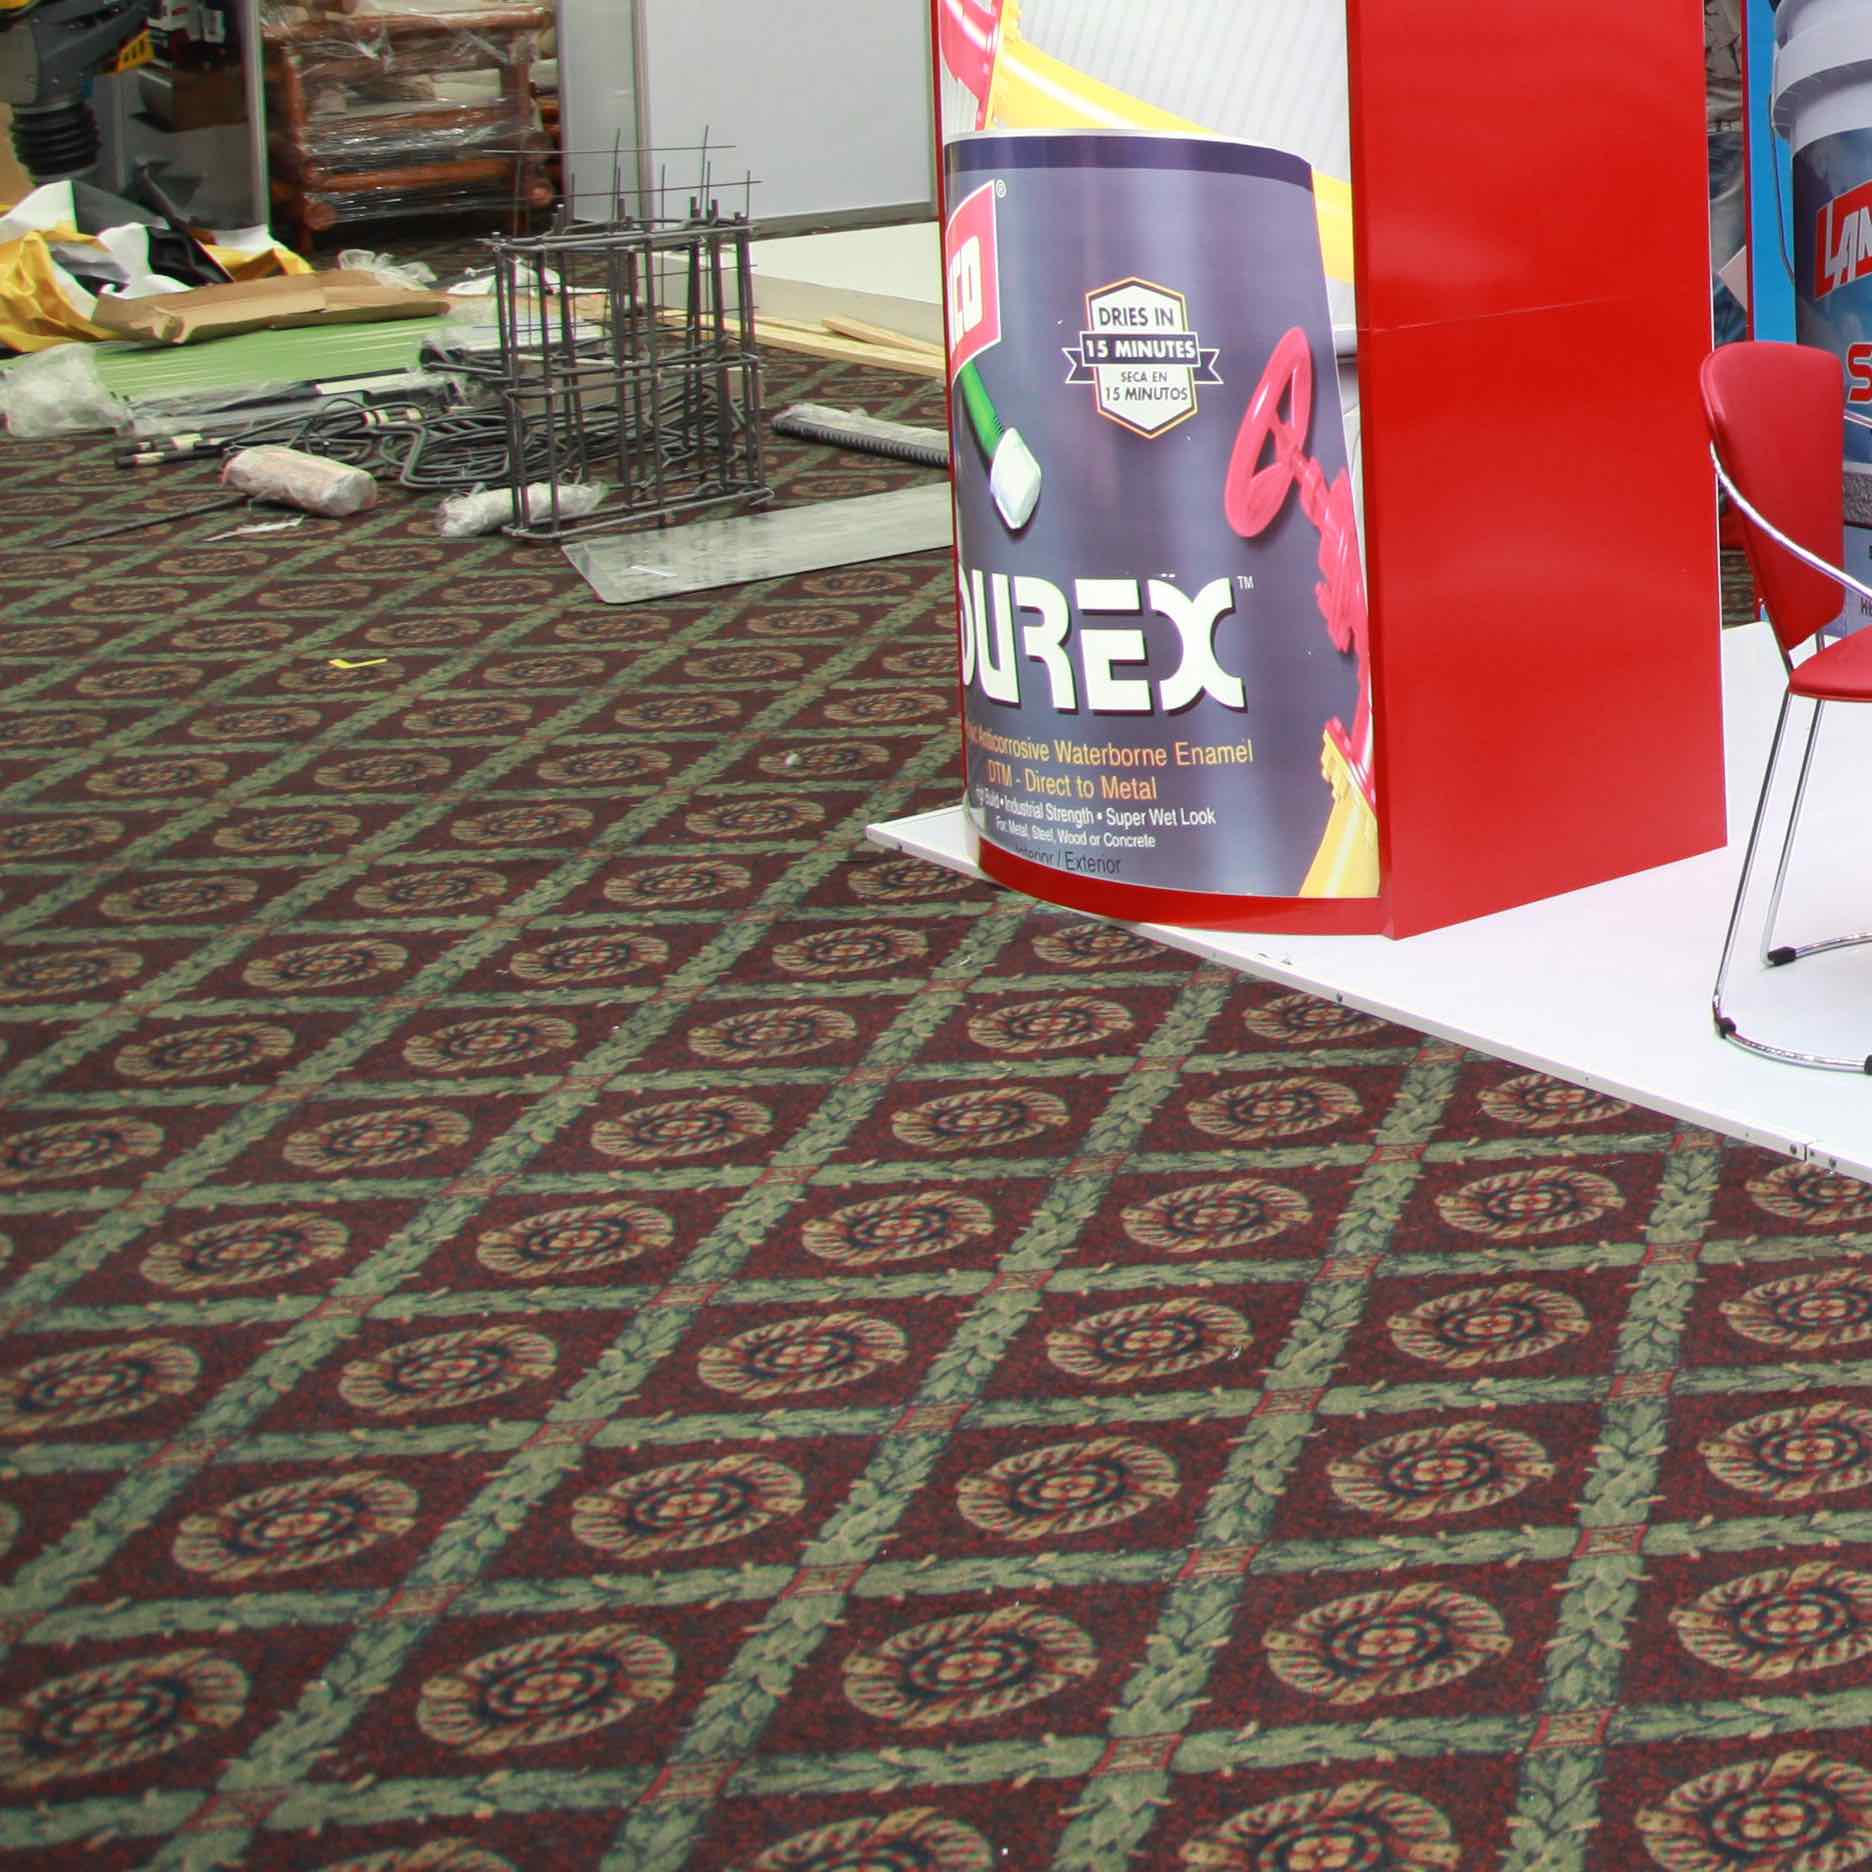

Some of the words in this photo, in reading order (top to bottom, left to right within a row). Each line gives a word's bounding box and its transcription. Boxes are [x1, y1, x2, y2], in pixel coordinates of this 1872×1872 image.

[1098, 307, 1149, 327] DRIES
[1154, 307, 1174, 327] IN
[1086, 340, 1109, 358] 15
[1115, 340, 1196, 358] MINUTES
[1121, 371, 1148, 383] SECA
[1152, 371, 1168, 383] EN
[1105, 387, 1121, 401] 15
[1125, 387, 1188, 401] MINUTOS
[1054, 739, 1168, 767] Waterborne
[1175, 738, 1254, 766] Enamel
[1024, 767, 1072, 798] Direct
[1077, 776, 1095, 799] to
[1101, 775, 1157, 801] Metal
[1046, 802, 1095, 828] Strength
[1106, 807, 1146, 830] Super
[1149, 808, 1177, 826] Wet
[1182, 807, 1217, 825] Look
[1057, 828, 1087, 845] Wood
[1089, 836, 1100, 846] or
[1103, 832, 1156, 849] Concrete
[1065, 851, 1121, 875] Exterior
